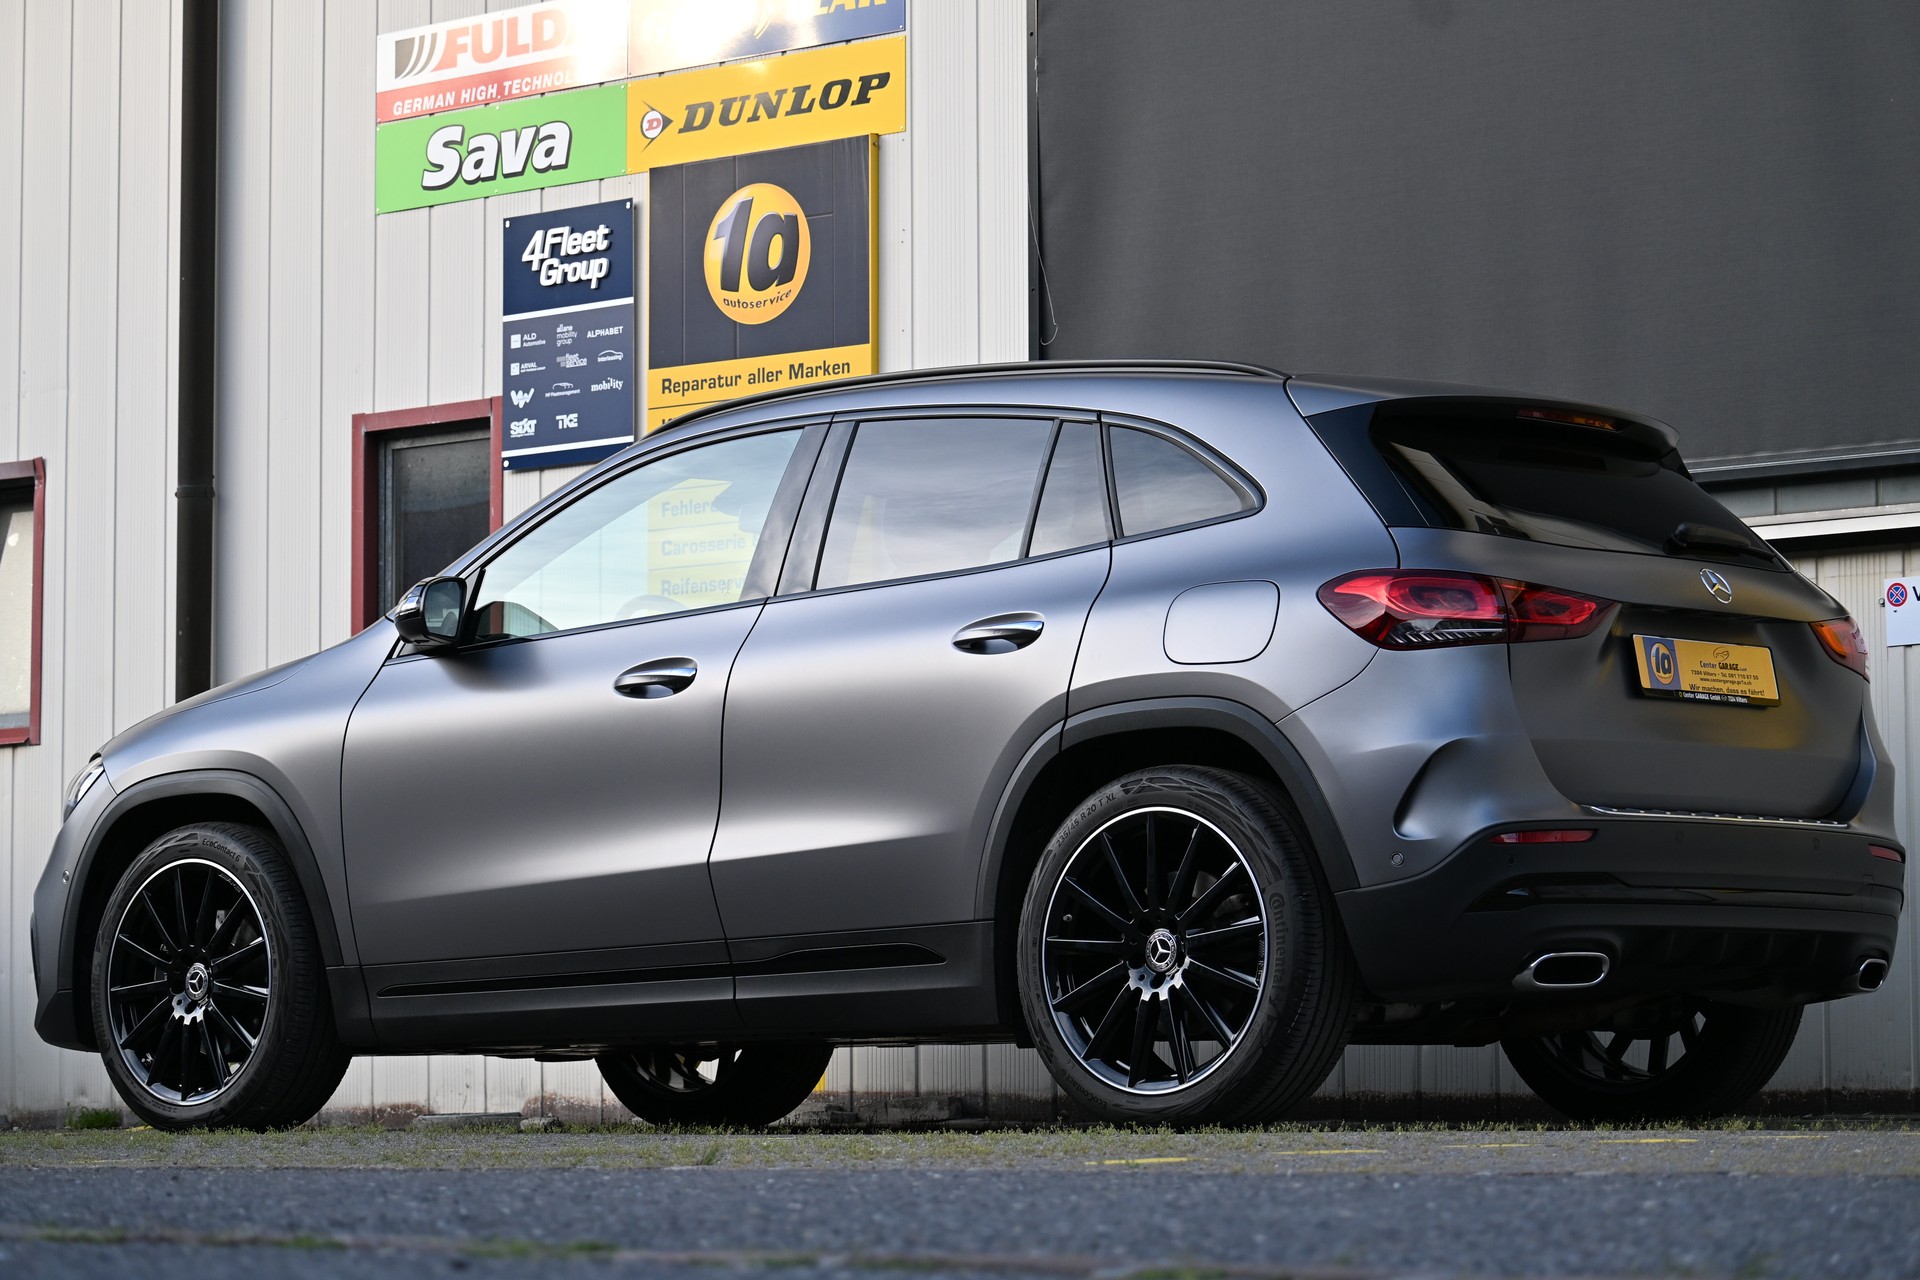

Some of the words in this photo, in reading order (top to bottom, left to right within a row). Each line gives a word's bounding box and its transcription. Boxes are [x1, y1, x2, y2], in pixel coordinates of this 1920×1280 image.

[431, 9, 576, 72] FULD
[392, 91, 456, 116] GERMAN
[460, 83, 498, 105] HIGH
[503, 69, 576, 97] TECHNOL
[678, 72, 890, 134] DUNLOP
[421, 121, 572, 191] Sava
[521, 224, 612, 272] 4Fleet
[713, 196, 800, 293] 1a
[540, 257, 610, 289] Group
[723, 288, 792, 309] autoservice
[523, 333, 537, 341] ALD
[556, 331, 578, 340] mobility
[587, 326, 624, 338] ALPHABET
[556, 339, 573, 347] group
[590, 377, 624, 392] mobility
[661, 374, 742, 397] Reparatur
[748, 367, 783, 385] aller
[788, 361, 851, 380] Marken
[661, 535, 746, 556] Carosserie
[1699, 660, 1717, 669] Center
[1718, 662, 1740, 671] GARAGE
[1689, 683, 1701, 691] Wir
[1701, 686, 1726, 694] machen,
[1726, 687, 1740, 695] dass
[1055, 817, 1080, 847] 235/45
[1080, 811, 1087, 821] R
[1086, 803, 1097, 816] 20
[1105, 792, 1117, 803] XL
[202, 838, 236, 859] EcoContact
